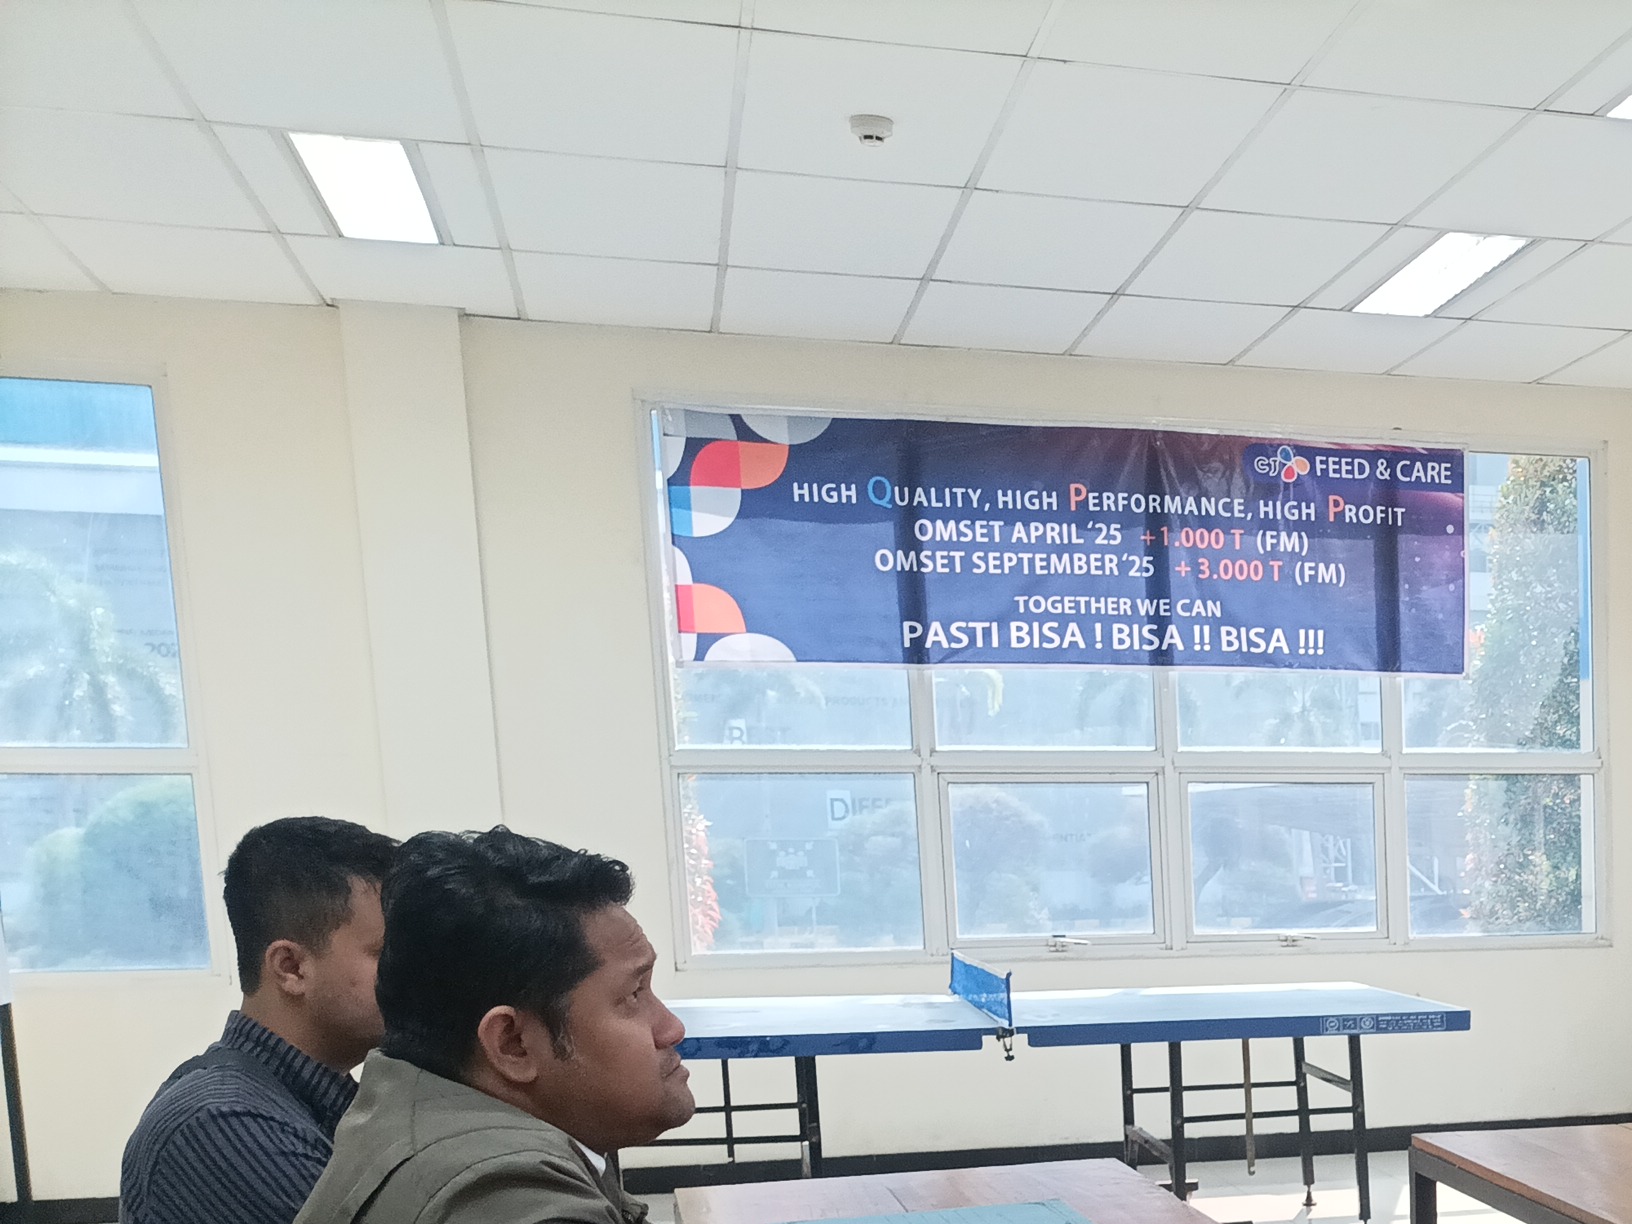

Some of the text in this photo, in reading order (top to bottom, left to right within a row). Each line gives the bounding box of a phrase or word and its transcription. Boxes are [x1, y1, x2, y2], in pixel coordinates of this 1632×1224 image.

[1315, 456, 1370, 480] FEED
[1376, 459, 1391, 481] &
[1396, 460, 1452, 484] CARE
[792, 476, 1406, 526] HIGH QUALITY, HIGH PERFORMANCE, HIGH PROFIT
[914, 519, 1004, 543] OMSET
[1011, 522, 1084, 544] APRIL
[1231, 529, 1244, 550] T
[1256, 531, 1309, 556] (FM)
[874, 549, 965, 574] OMSET
[972, 551, 1119, 576] SEPTEMBER
[1269, 561, 1282, 581] T
[1295, 562, 1346, 587] (FM)
[1014, 595, 1221, 618] TOGETHER WE CAN
[903, 620, 1324, 656] PASTI BISA ! BISA !! BISA !!!
